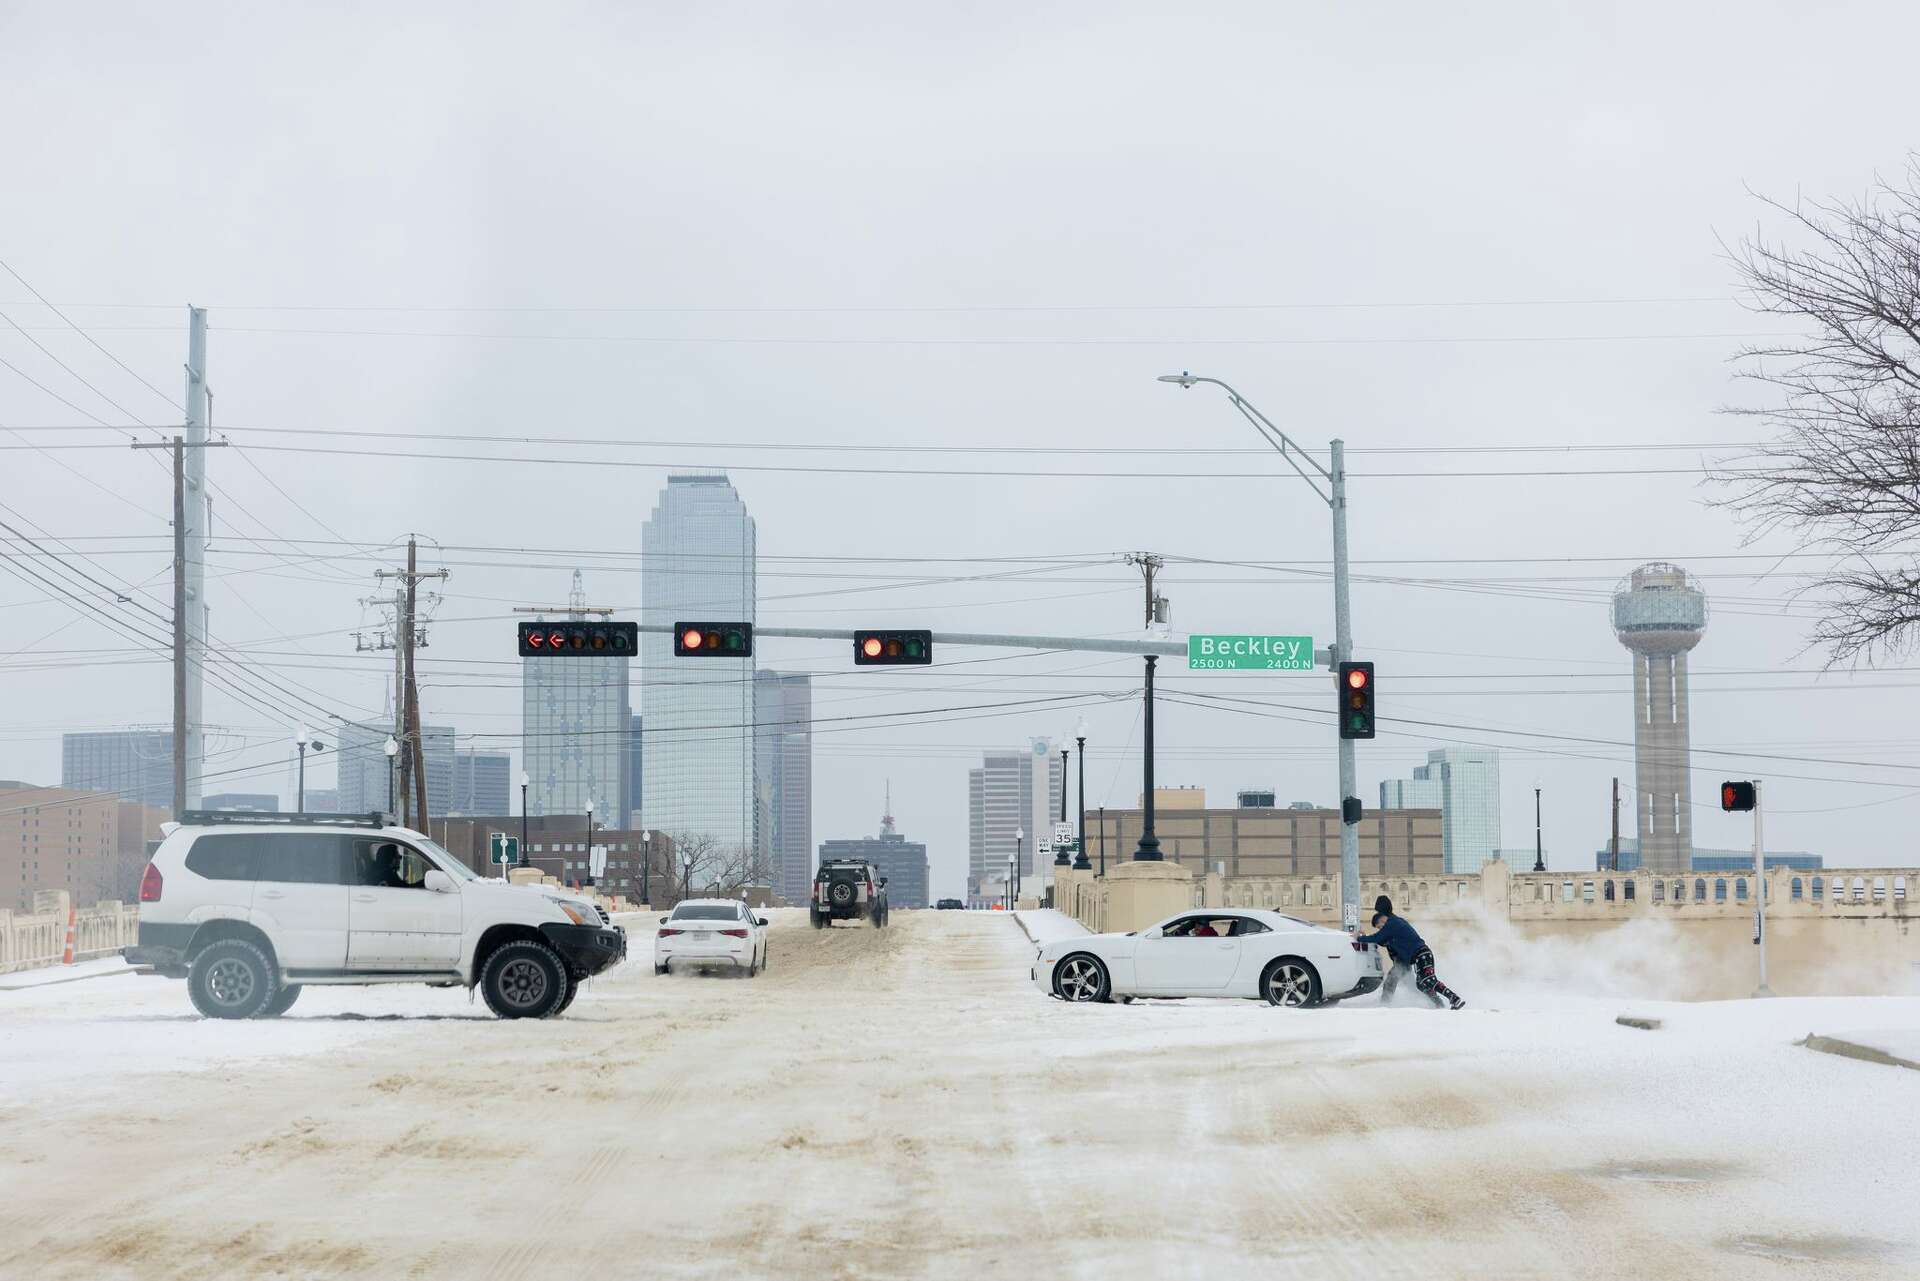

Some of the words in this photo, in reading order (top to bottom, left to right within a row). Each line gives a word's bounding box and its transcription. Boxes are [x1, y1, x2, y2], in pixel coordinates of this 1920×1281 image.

[1201, 638, 1300, 660] Beckley
[1191, 659, 1224, 668] 2500
[1227, 659, 1236, 668] N
[1266, 659, 1299, 669] 2400
[1302, 659, 1311, 669] N
[1056, 834, 1071, 844] 35
